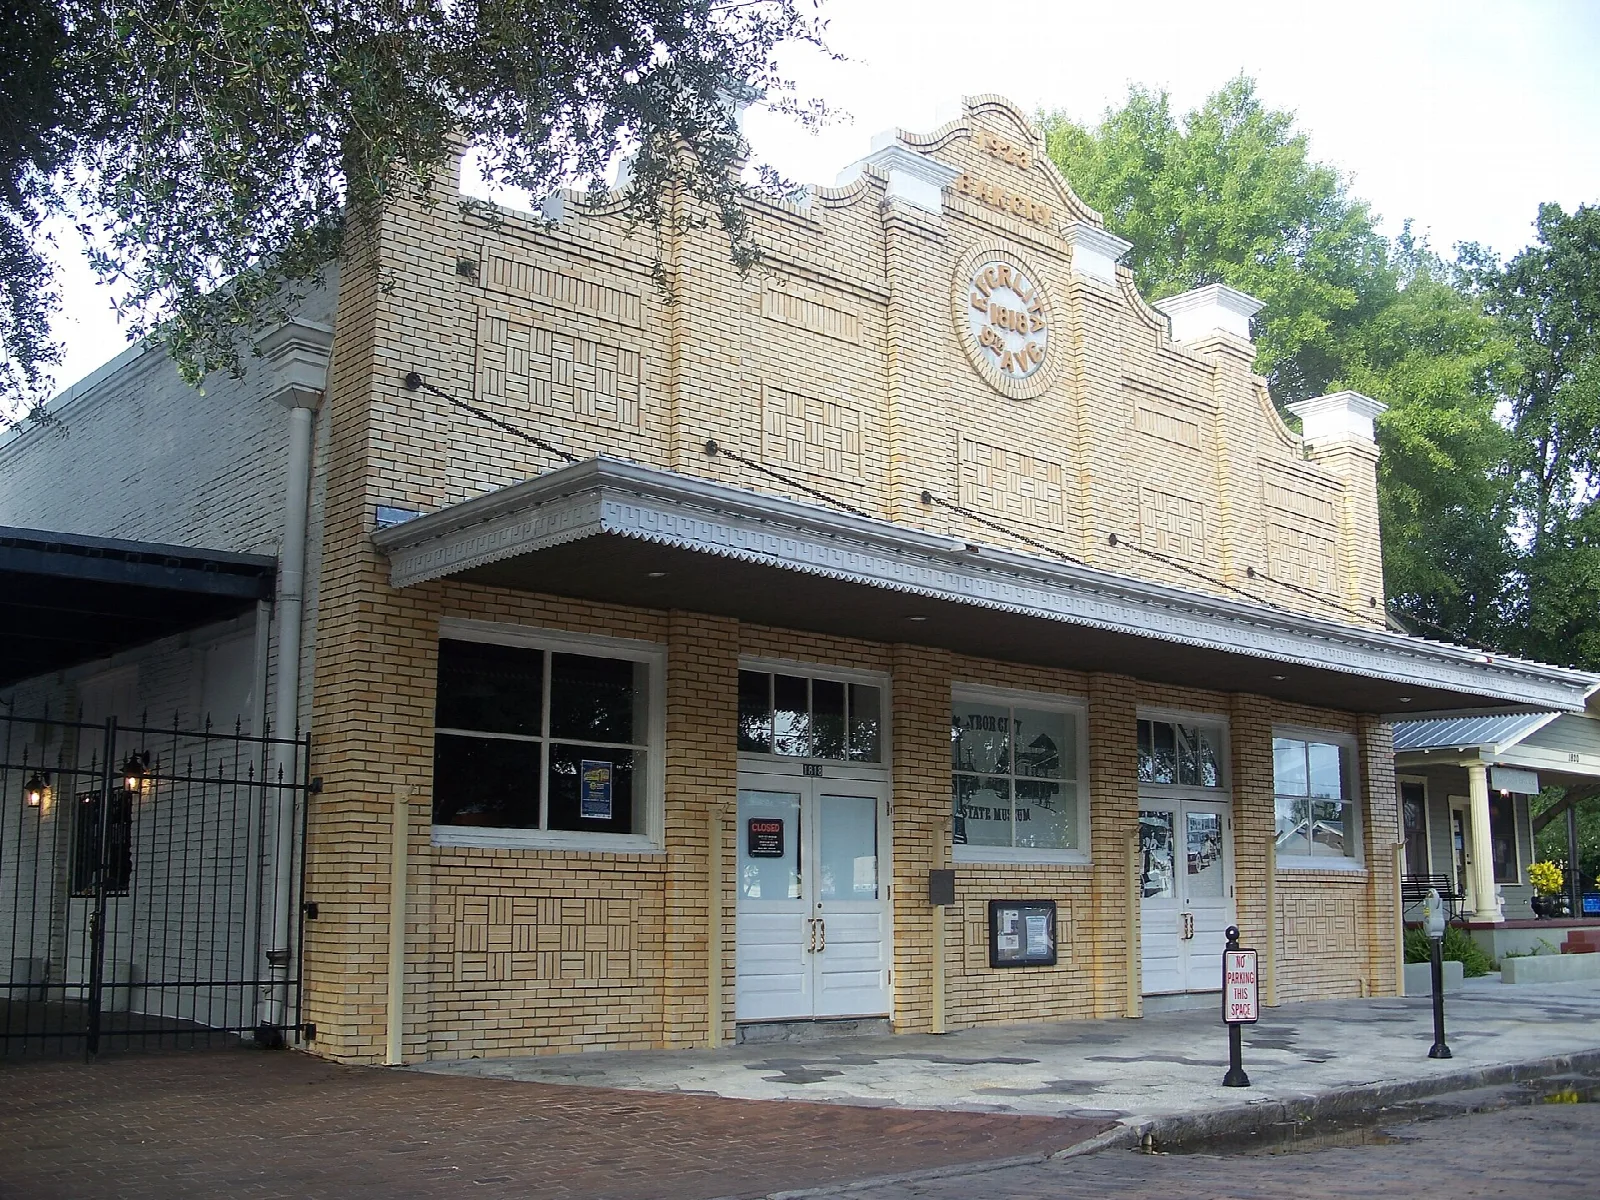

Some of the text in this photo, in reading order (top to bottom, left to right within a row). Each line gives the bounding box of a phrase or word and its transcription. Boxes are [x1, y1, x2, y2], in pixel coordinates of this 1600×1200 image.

[957, 172, 1051, 226] BAKERY
[990, 303, 1028, 335] 1818
[968, 715, 1023, 734] YBOR CIY
[804, 765, 822, 775] 1818
[962, 805, 990, 820] STATE
[752, 824, 780, 832] CLOSED
[1236, 955, 1245, 968] NO
[1227, 972, 1254, 984] PARKING
[1234, 988, 1248, 999] THIS
[1231, 1004, 1251, 1015] SPACE
